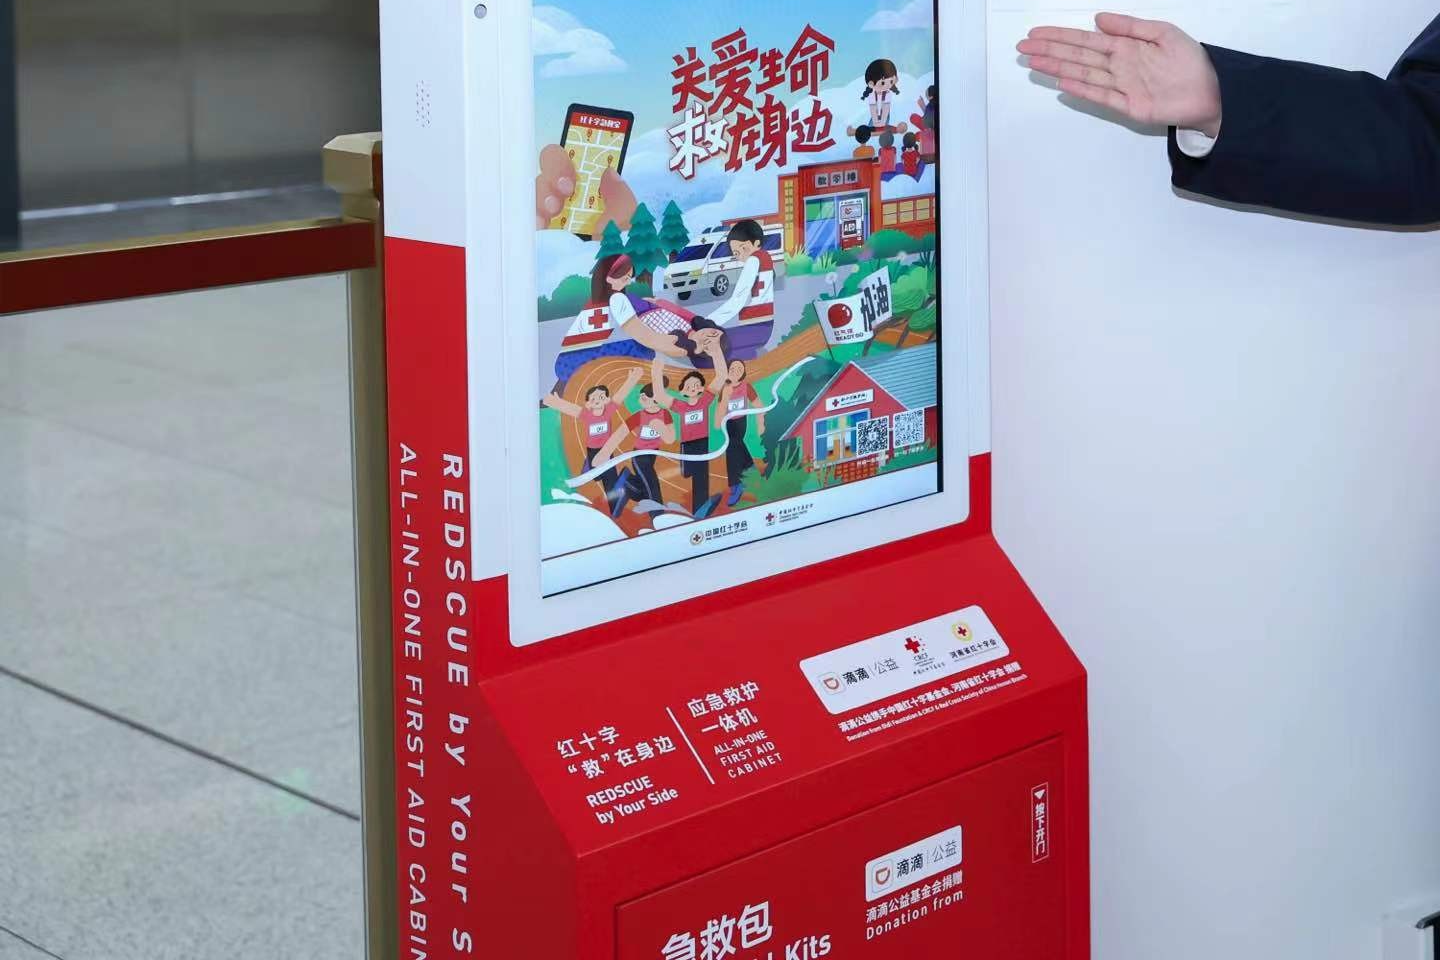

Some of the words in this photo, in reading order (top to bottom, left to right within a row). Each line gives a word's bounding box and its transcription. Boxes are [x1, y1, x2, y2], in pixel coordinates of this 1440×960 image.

[671, 23, 835, 117] 关爱生命
[666, 93, 837, 180] 救在身边
[860, 276, 889, 332] 加油
[400, 443, 422, 661] ALL-IN-ONE
[442, 453, 469, 687] REDSCUE
[687, 681, 760, 719] 应急救护
[701, 707, 759, 734] 一体机
[405, 674, 424, 778] FIRST
[445, 712, 469, 766] by
[556, 725, 620, 759] 红十字
[713, 729, 768, 756] ALL-IN-ONE
[720, 747, 753, 767] FIRST
[755, 740, 776, 756] AID
[727, 752, 783, 779] CABINET
[585, 775, 654, 809] REDSCUE
[595, 809, 615, 825] by
[613, 798, 646, 818] Your
[649, 786, 679, 806] Side
[408, 787, 425, 848] AID
[451, 794, 471, 904] Your
[896, 853, 924, 879] 滴滴
[932, 839, 957, 863] 公益
[866, 869, 963, 924] 滴滴公益基金会捐赠
[866, 905, 928, 940] Donation
[933, 890, 963, 912] from
[785, 934, 832, 960] Kits
